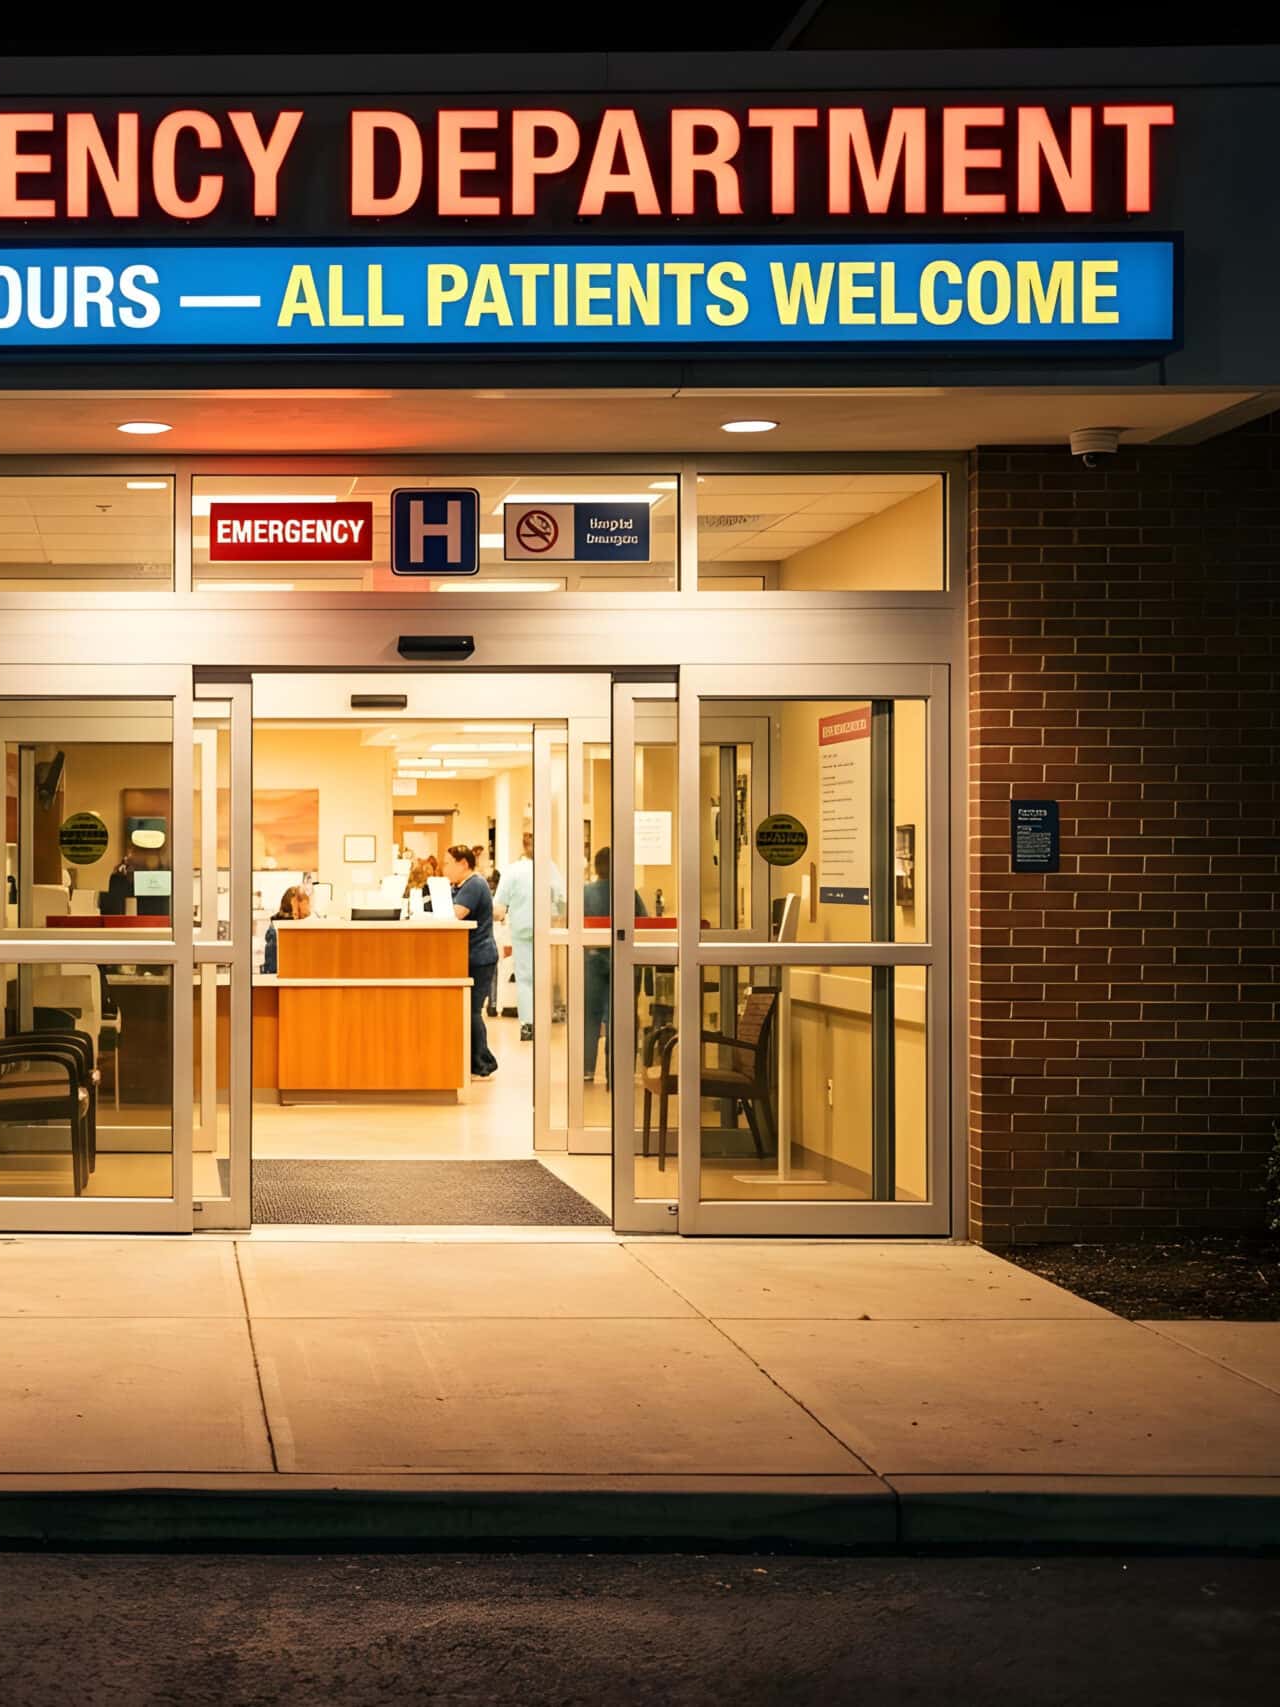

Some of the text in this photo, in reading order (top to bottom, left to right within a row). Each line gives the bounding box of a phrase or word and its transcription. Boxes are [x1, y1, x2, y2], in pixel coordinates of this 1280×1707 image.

[350, 104, 1175, 217] DEPARTMENT
[276, 264, 406, 328] ALL
[426, 261, 750, 327] PATIENTS
[768, 260, 1120, 326] WELCOME
[216, 518, 365, 545] EMERGENCY
[409, 500, 462, 563] H
